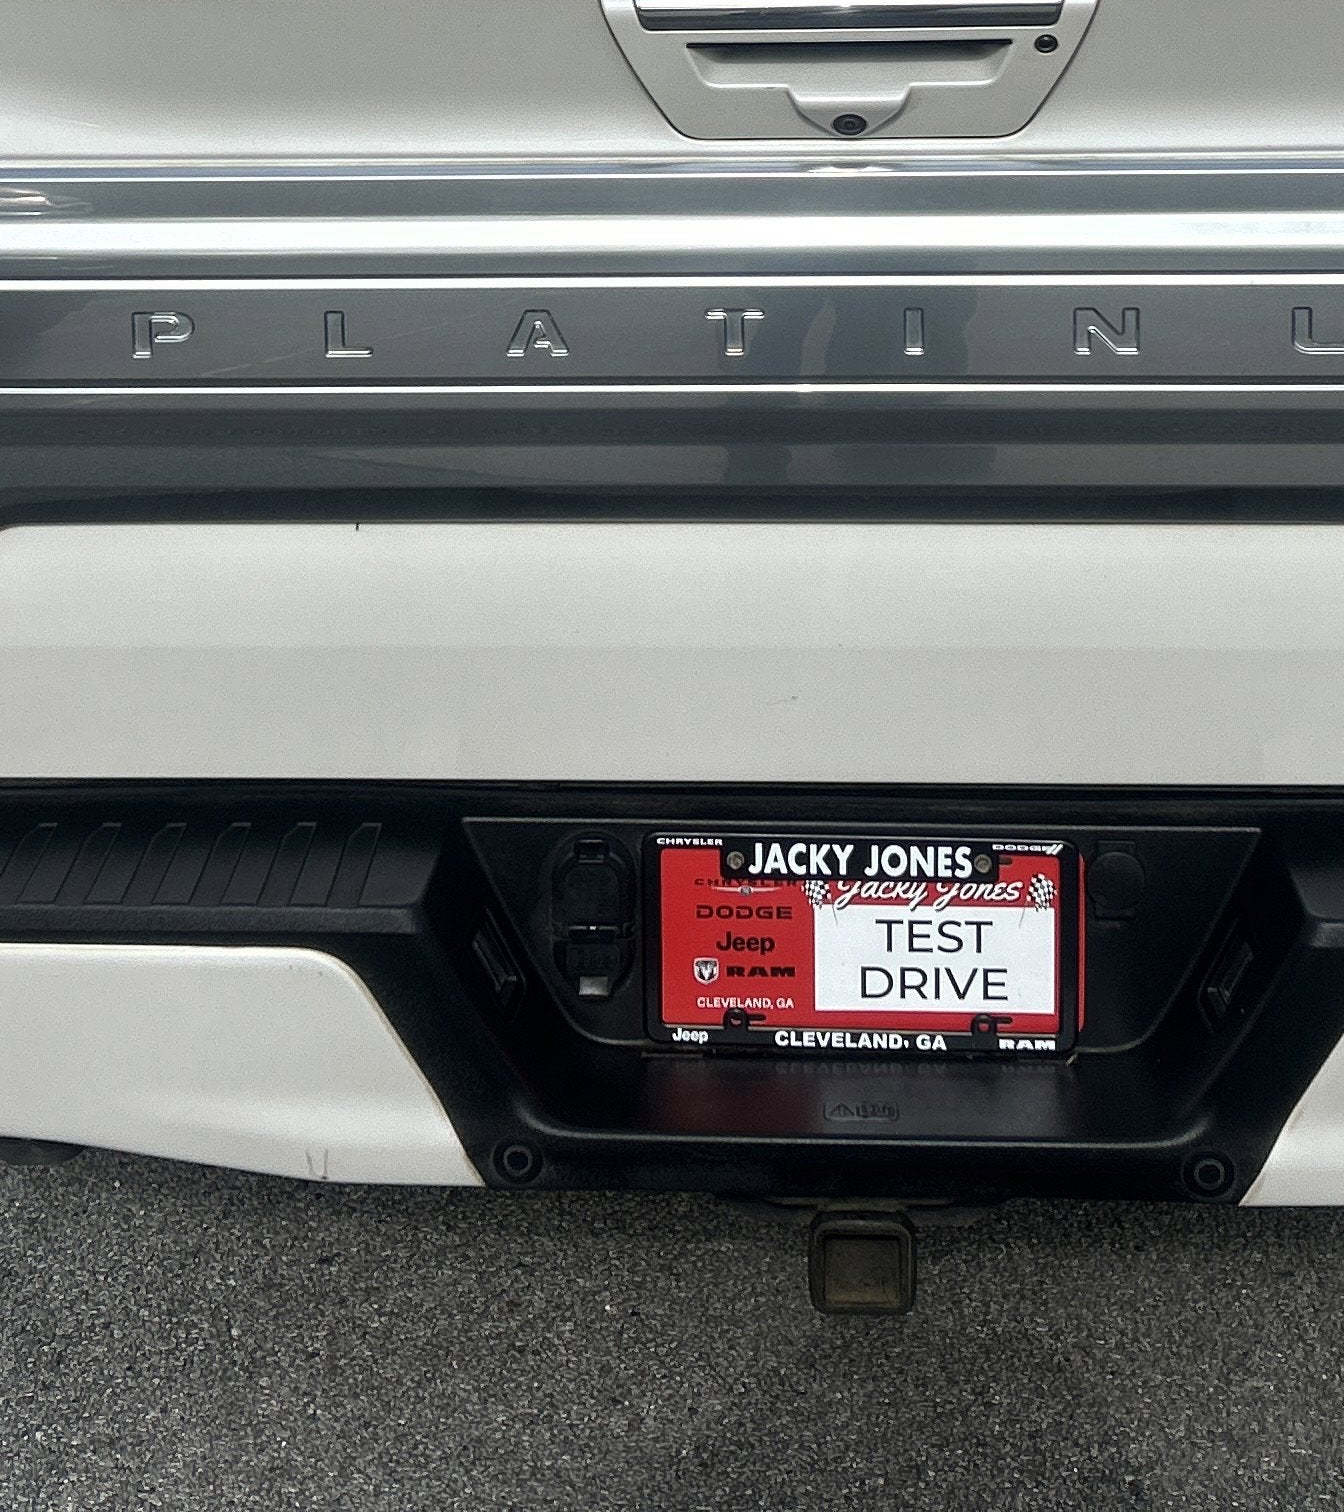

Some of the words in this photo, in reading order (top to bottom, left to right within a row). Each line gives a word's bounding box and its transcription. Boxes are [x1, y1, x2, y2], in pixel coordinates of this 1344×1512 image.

[656, 838, 723, 846] CHRYSLER
[748, 842, 854, 876] JACKY
[864, 844, 973, 879] JONES
[696, 904, 793, 920] DODGE
[716, 931, 776, 955] Jeep
[875, 918, 994, 954] TEST
[726, 965, 796, 978] RAM
[860, 966, 1009, 1001] DRIVE
[696, 996, 774, 1010] CLEVELAND,
[776, 997, 795, 1009] GA
[672, 1027, 709, 1045] Jeep
[774, 1030, 910, 1050] CLEVELAND,
[915, 1034, 948, 1051] GA
[998, 1038, 1056, 1051] RAM
